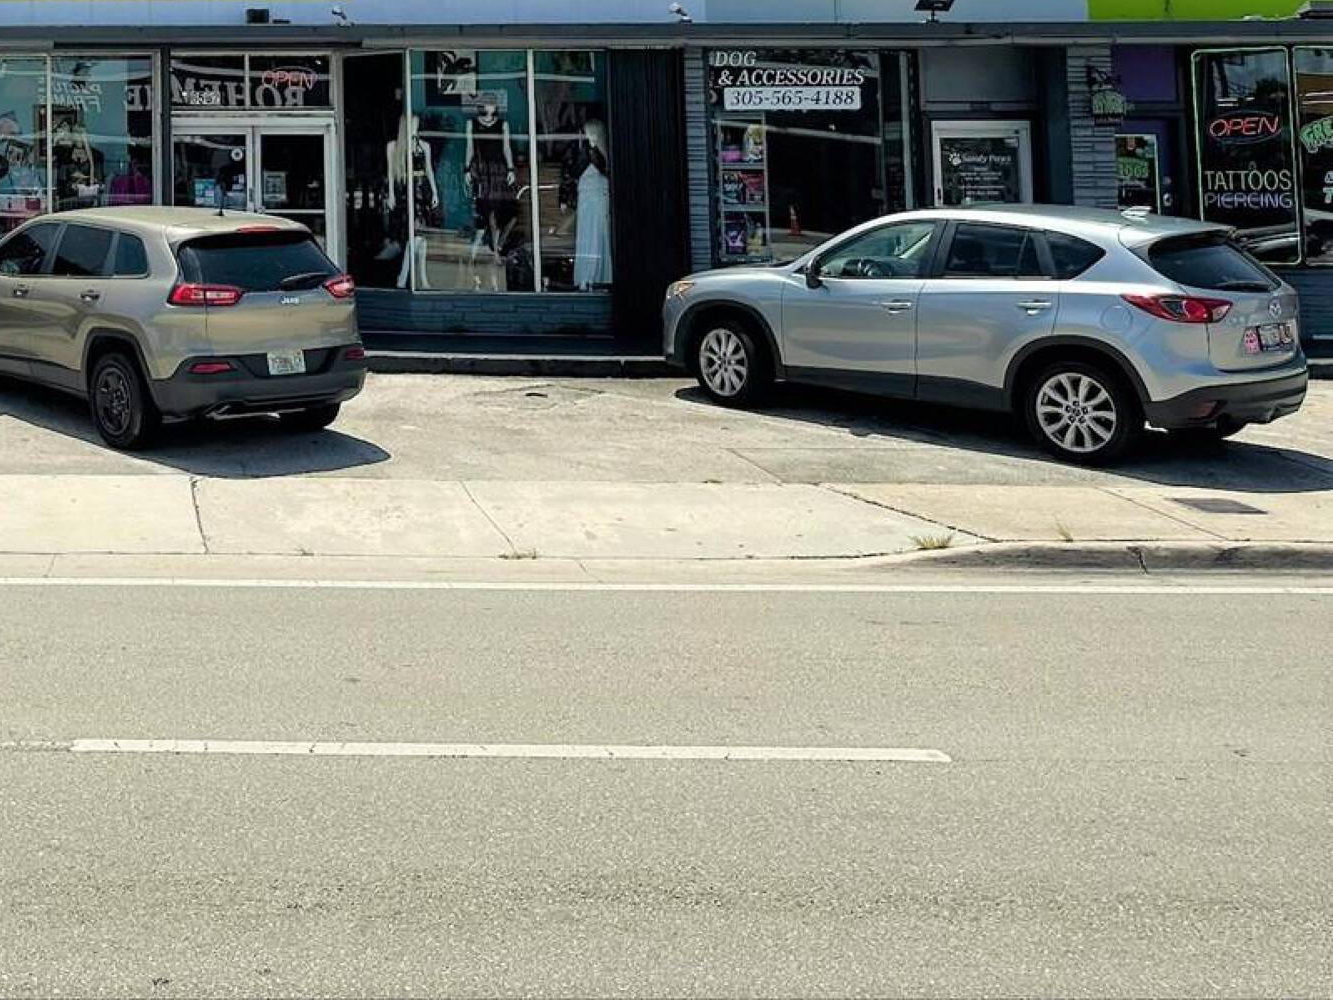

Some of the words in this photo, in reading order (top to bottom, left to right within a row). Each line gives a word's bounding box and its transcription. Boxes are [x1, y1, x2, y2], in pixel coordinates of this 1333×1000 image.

[715, 50, 757, 67] DOG
[718, 69, 734, 85] &
[736, 68, 865, 85] ACCESSORIES
[730, 89, 856, 106] 305-565-4188
[1209, 115, 1279, 136] OPEN
[1203, 169, 1293, 191] TATTOOS
[1204, 193, 1293, 209] PIERCING
